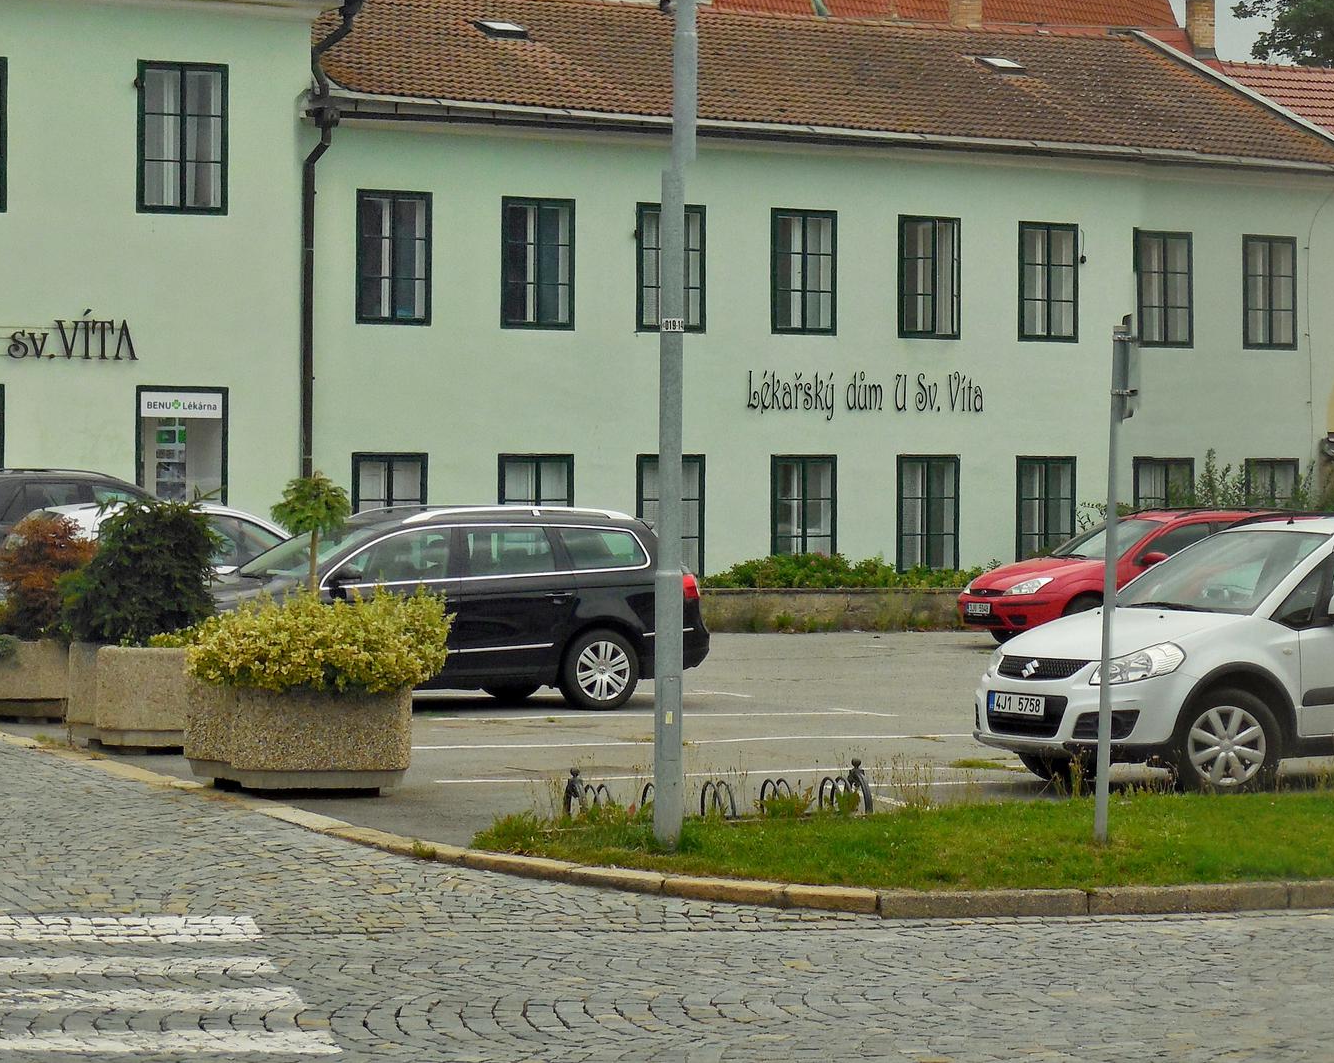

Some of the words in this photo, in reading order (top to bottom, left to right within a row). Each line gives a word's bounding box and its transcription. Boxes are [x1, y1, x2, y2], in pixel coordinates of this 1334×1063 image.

[747, 370, 834, 421] Lékařský
[846, 371, 883, 411] dům
[895, 373, 907, 412] U
[915, 373, 941, 412] Sv.
[948, 371, 984, 413] Víta
[147, 401, 172, 410] BENU
[182, 401, 217, 411] Lékárna
[995, 695, 1012, 711] 4J1
[1018, 697, 1041, 713] 5758
